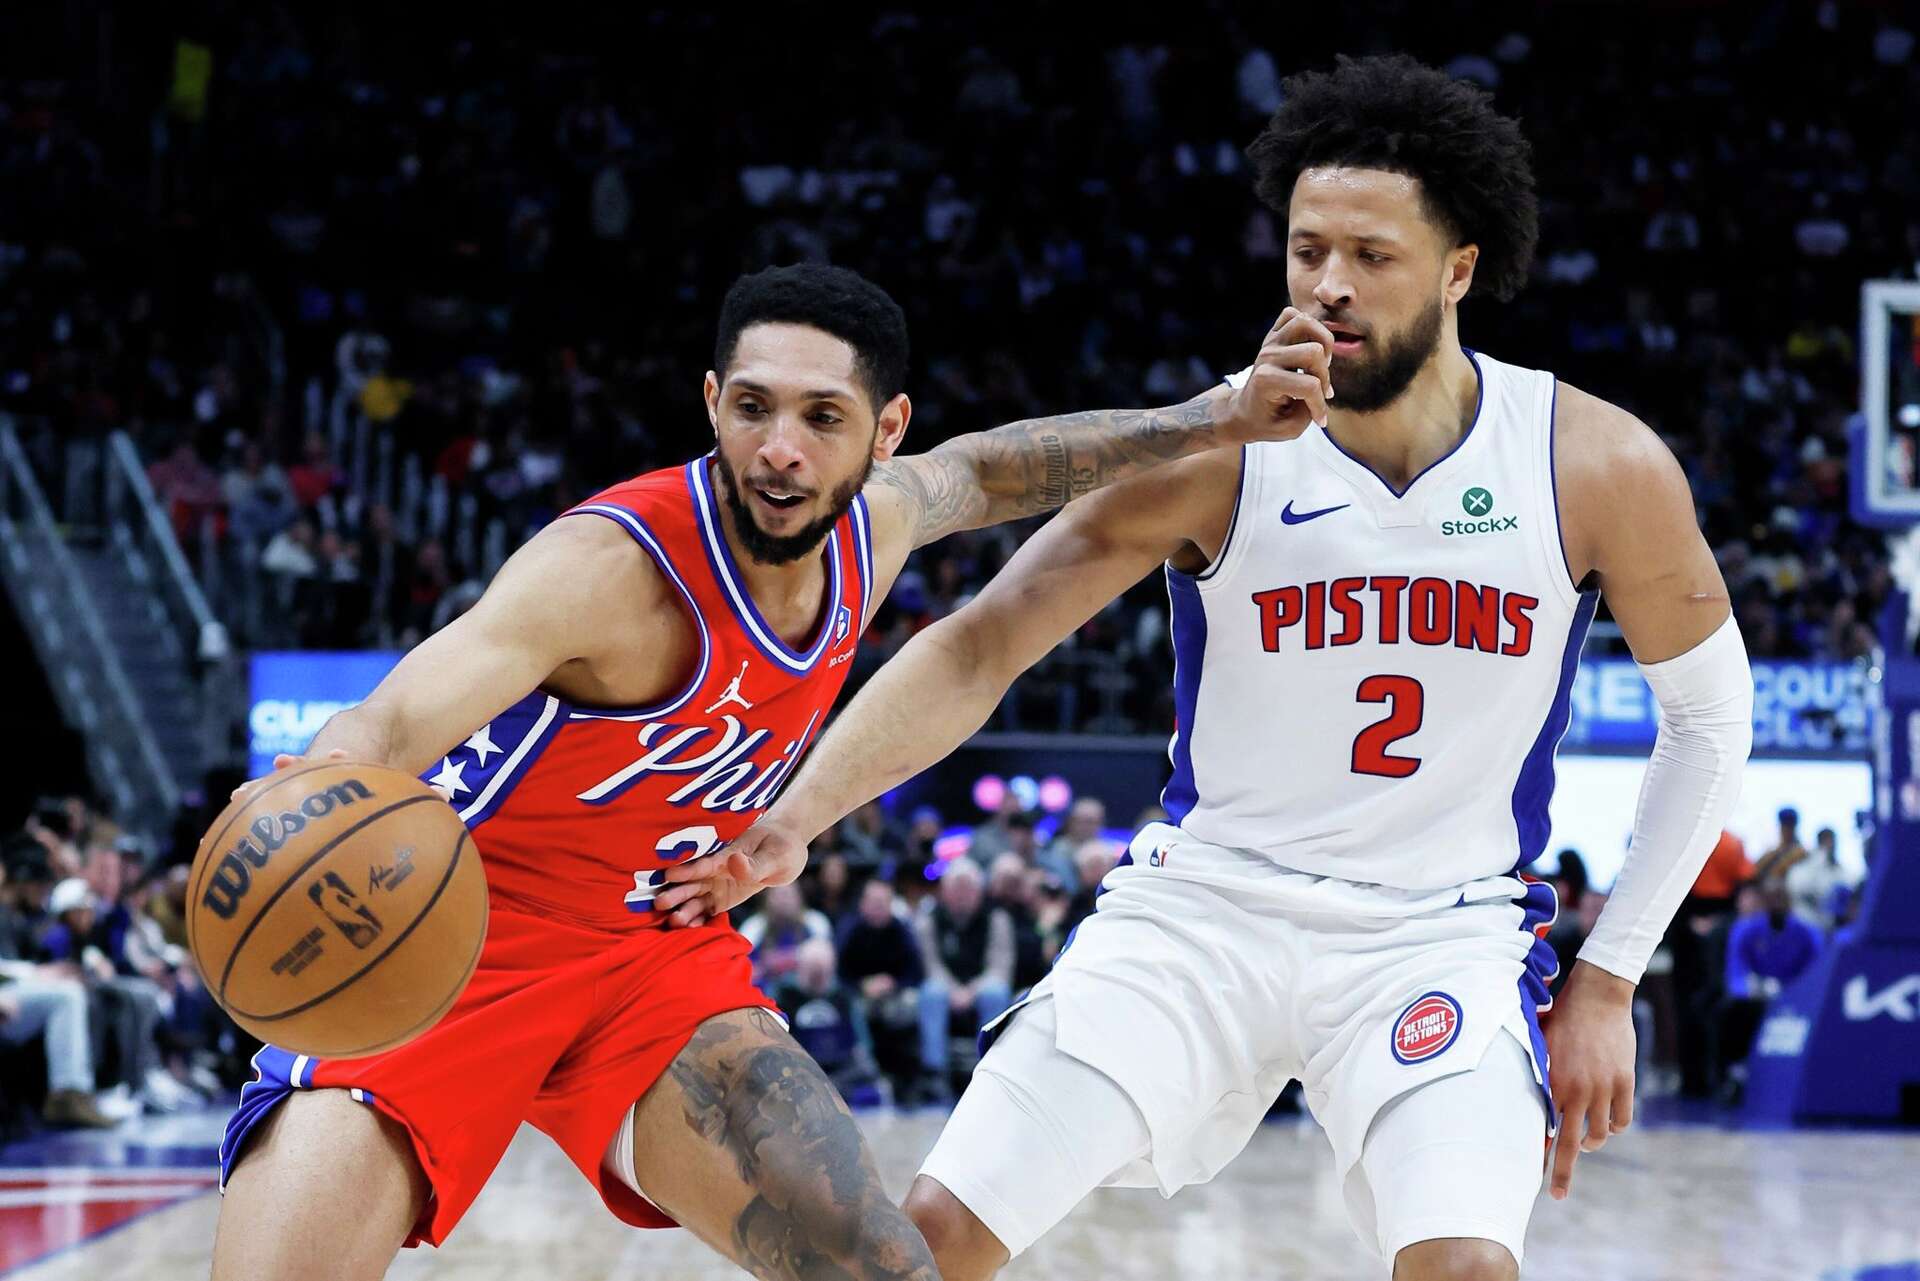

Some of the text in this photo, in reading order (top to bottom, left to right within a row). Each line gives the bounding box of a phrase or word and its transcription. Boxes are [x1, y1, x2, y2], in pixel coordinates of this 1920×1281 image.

[1441, 515, 1518, 536] StockX
[1251, 576, 1539, 657] PISTONS
[1351, 674, 1424, 779] 2
[203, 779, 376, 920] Wilson
[624, 825, 733, 913] 2
[1403, 1010, 1447, 1036] DETROIT
[1403, 1021, 1448, 1048] PISTONS
